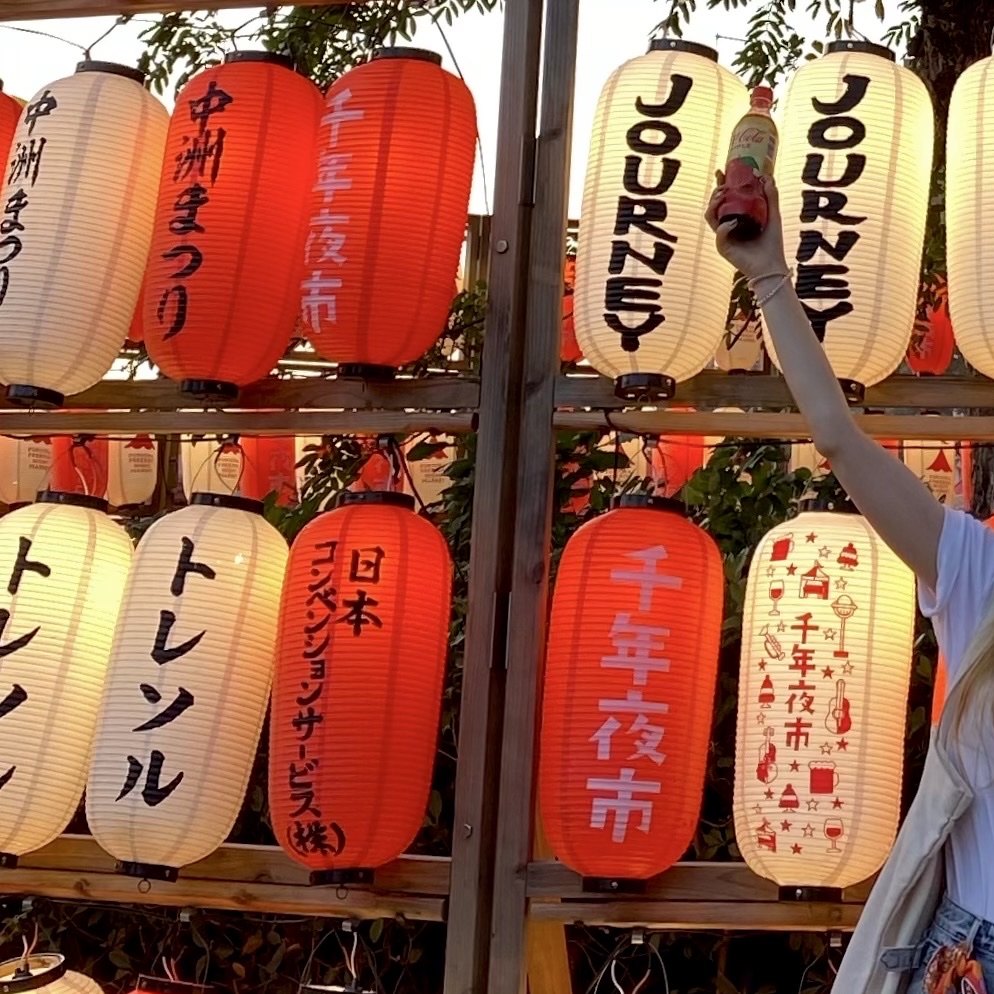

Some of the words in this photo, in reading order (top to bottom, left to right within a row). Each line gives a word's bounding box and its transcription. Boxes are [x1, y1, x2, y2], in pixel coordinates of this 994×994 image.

[156, 81, 233, 341] 中洲まつり
[301, 88, 364, 333] 千年夜市
[602, 73, 693, 352] JOURNEY
[796, 74, 871, 343] JOURNEY
[335, 546, 385, 637] 日本
[586, 545, 683, 843] 千年夜市
[784, 611, 819, 751] 千年夜市
